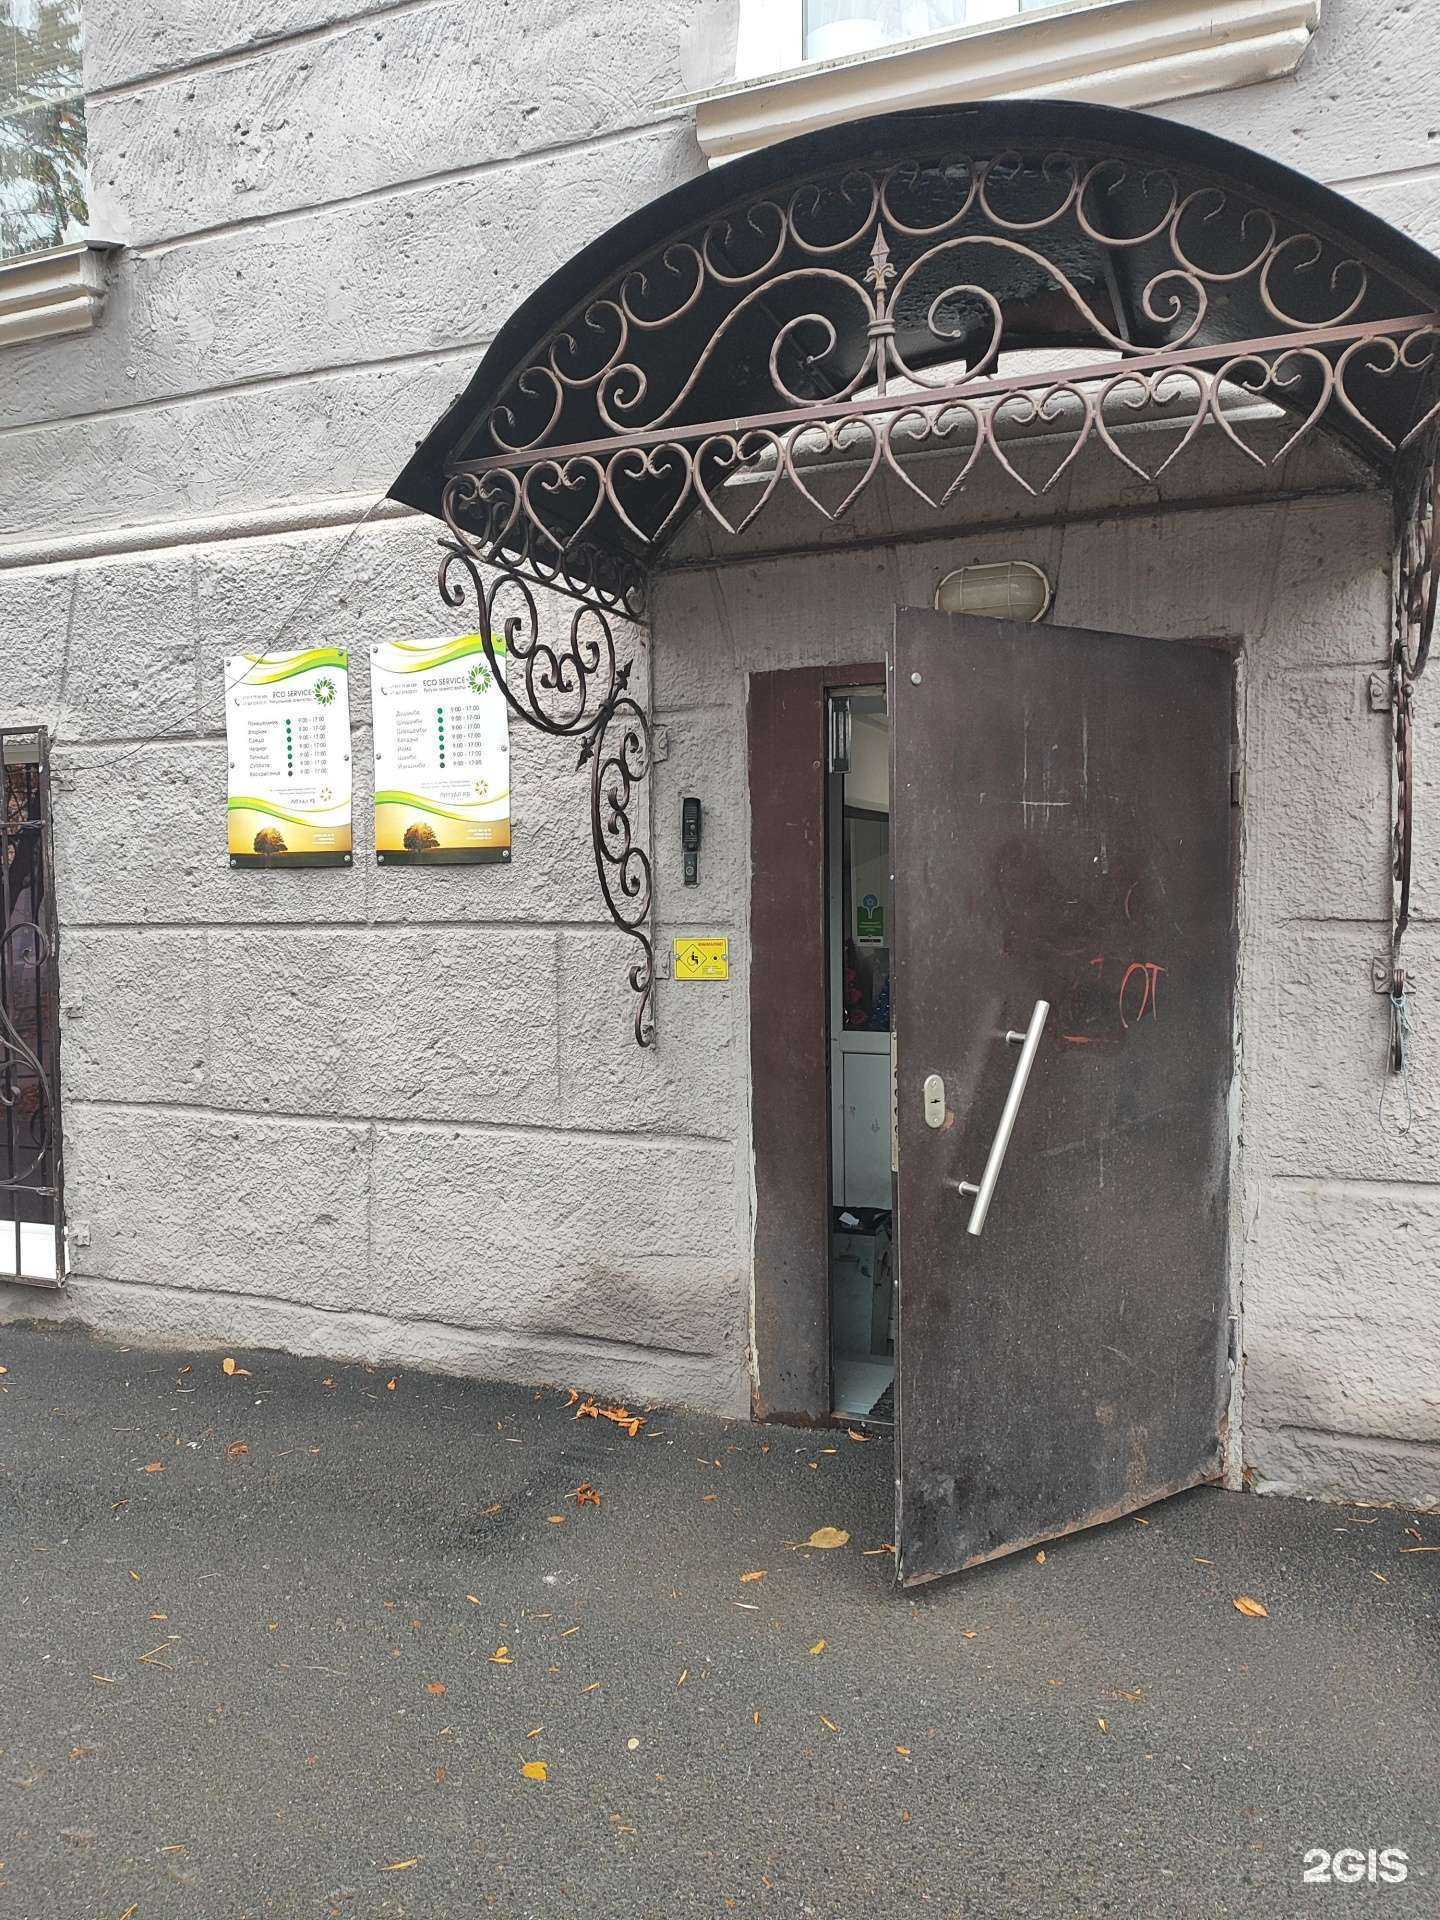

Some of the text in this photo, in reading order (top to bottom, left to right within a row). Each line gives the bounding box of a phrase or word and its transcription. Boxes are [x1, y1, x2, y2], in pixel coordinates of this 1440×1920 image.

[422, 679, 437, 687] ECO
[438, 676, 465, 686] SERVICE
[287, 688, 312, 698] SERVICE
